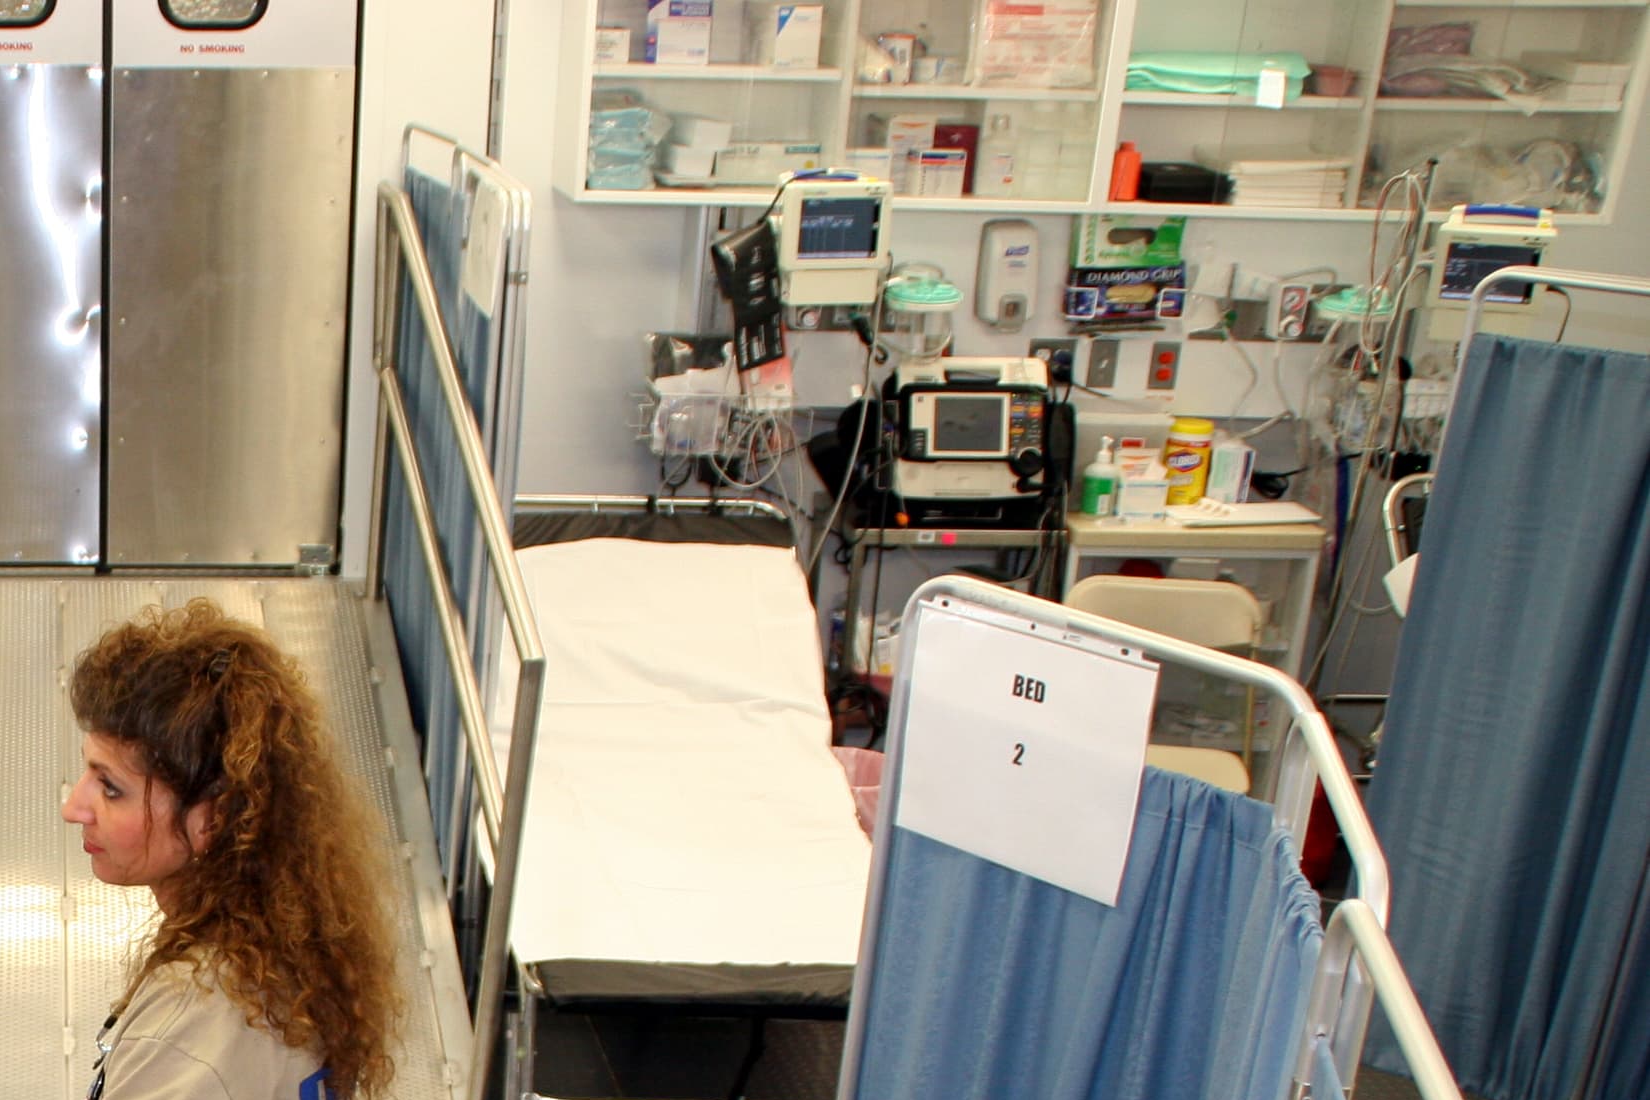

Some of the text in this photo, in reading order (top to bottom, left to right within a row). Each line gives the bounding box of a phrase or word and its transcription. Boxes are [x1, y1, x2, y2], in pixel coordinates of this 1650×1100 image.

[180, 45, 245, 53] NO SMOKING
[1086, 269, 1150, 283] DIAMOND
[1012, 674, 1046, 704] BED
[1012, 743, 1025, 765] 2
